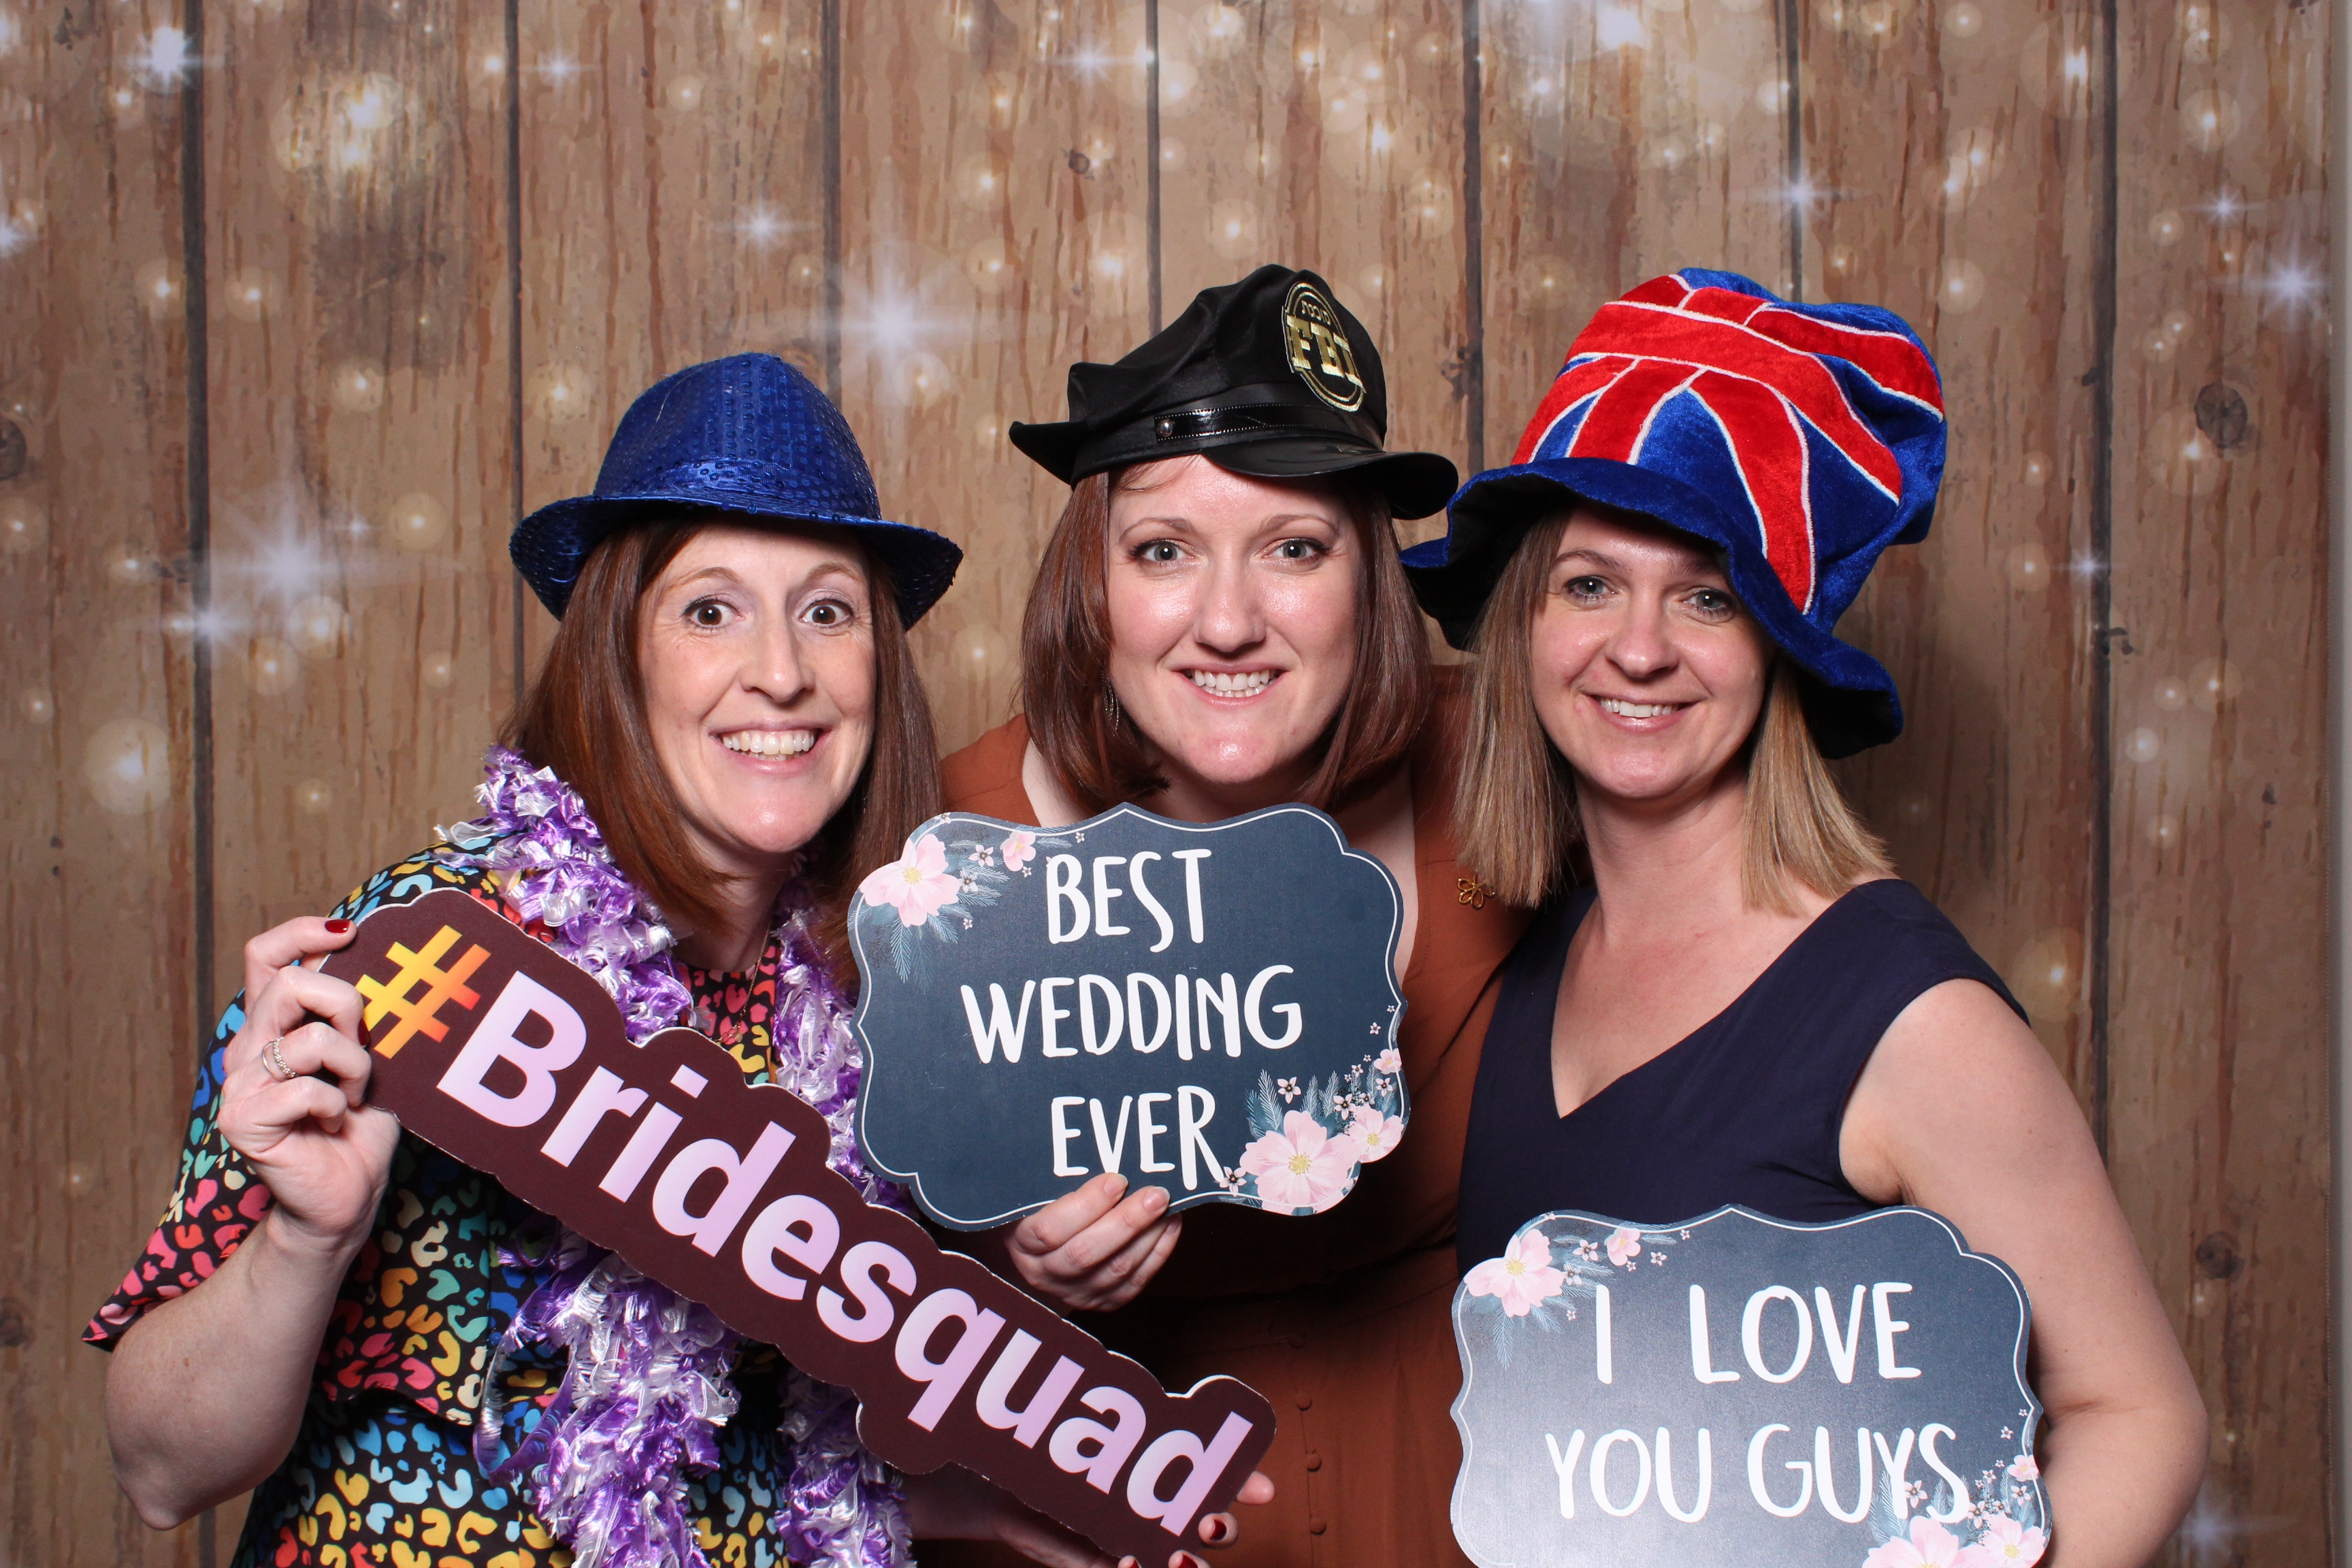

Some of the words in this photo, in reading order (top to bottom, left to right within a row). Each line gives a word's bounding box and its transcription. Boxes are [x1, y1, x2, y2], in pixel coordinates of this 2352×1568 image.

[1286, 314, 1364, 389] FBI
[1045, 848, 1212, 953] BEST
[960, 964, 1303, 1064] WEDDING
[1051, 1085, 1226, 1191] EVER
[355, 924, 1253, 1537] #Bridesquad
[1595, 1284, 1613, 1385] I
[1688, 1282, 1922, 1385] LOVE
[1545, 1426, 1712, 1523] YOU
[1747, 1423, 1971, 1524] GUYS
